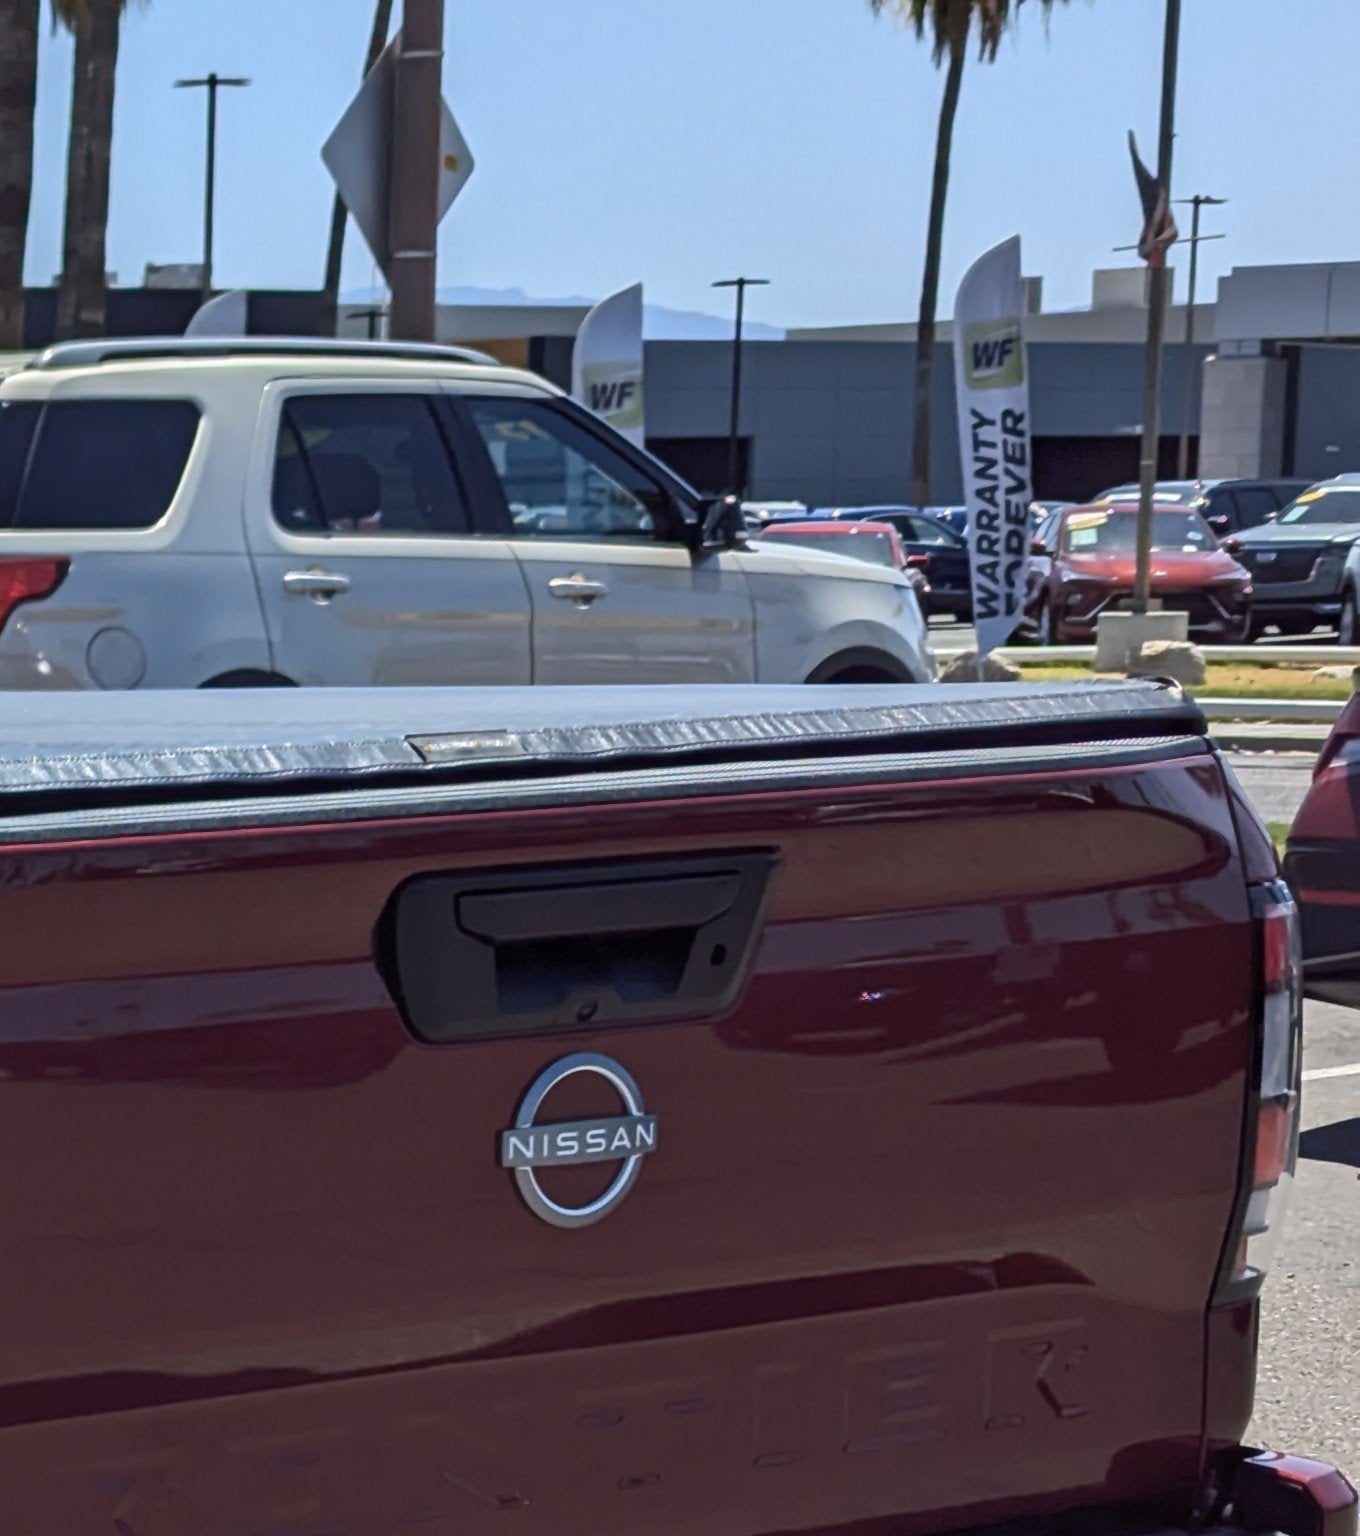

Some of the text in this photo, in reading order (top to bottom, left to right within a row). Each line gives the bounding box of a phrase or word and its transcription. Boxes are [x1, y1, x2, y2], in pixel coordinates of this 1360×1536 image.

[973, 338, 1014, 370] WF
[591, 382, 635, 410] WF
[970, 407, 1001, 619] WARRANTY
[508, 1123, 655, 1160] NISSAN
